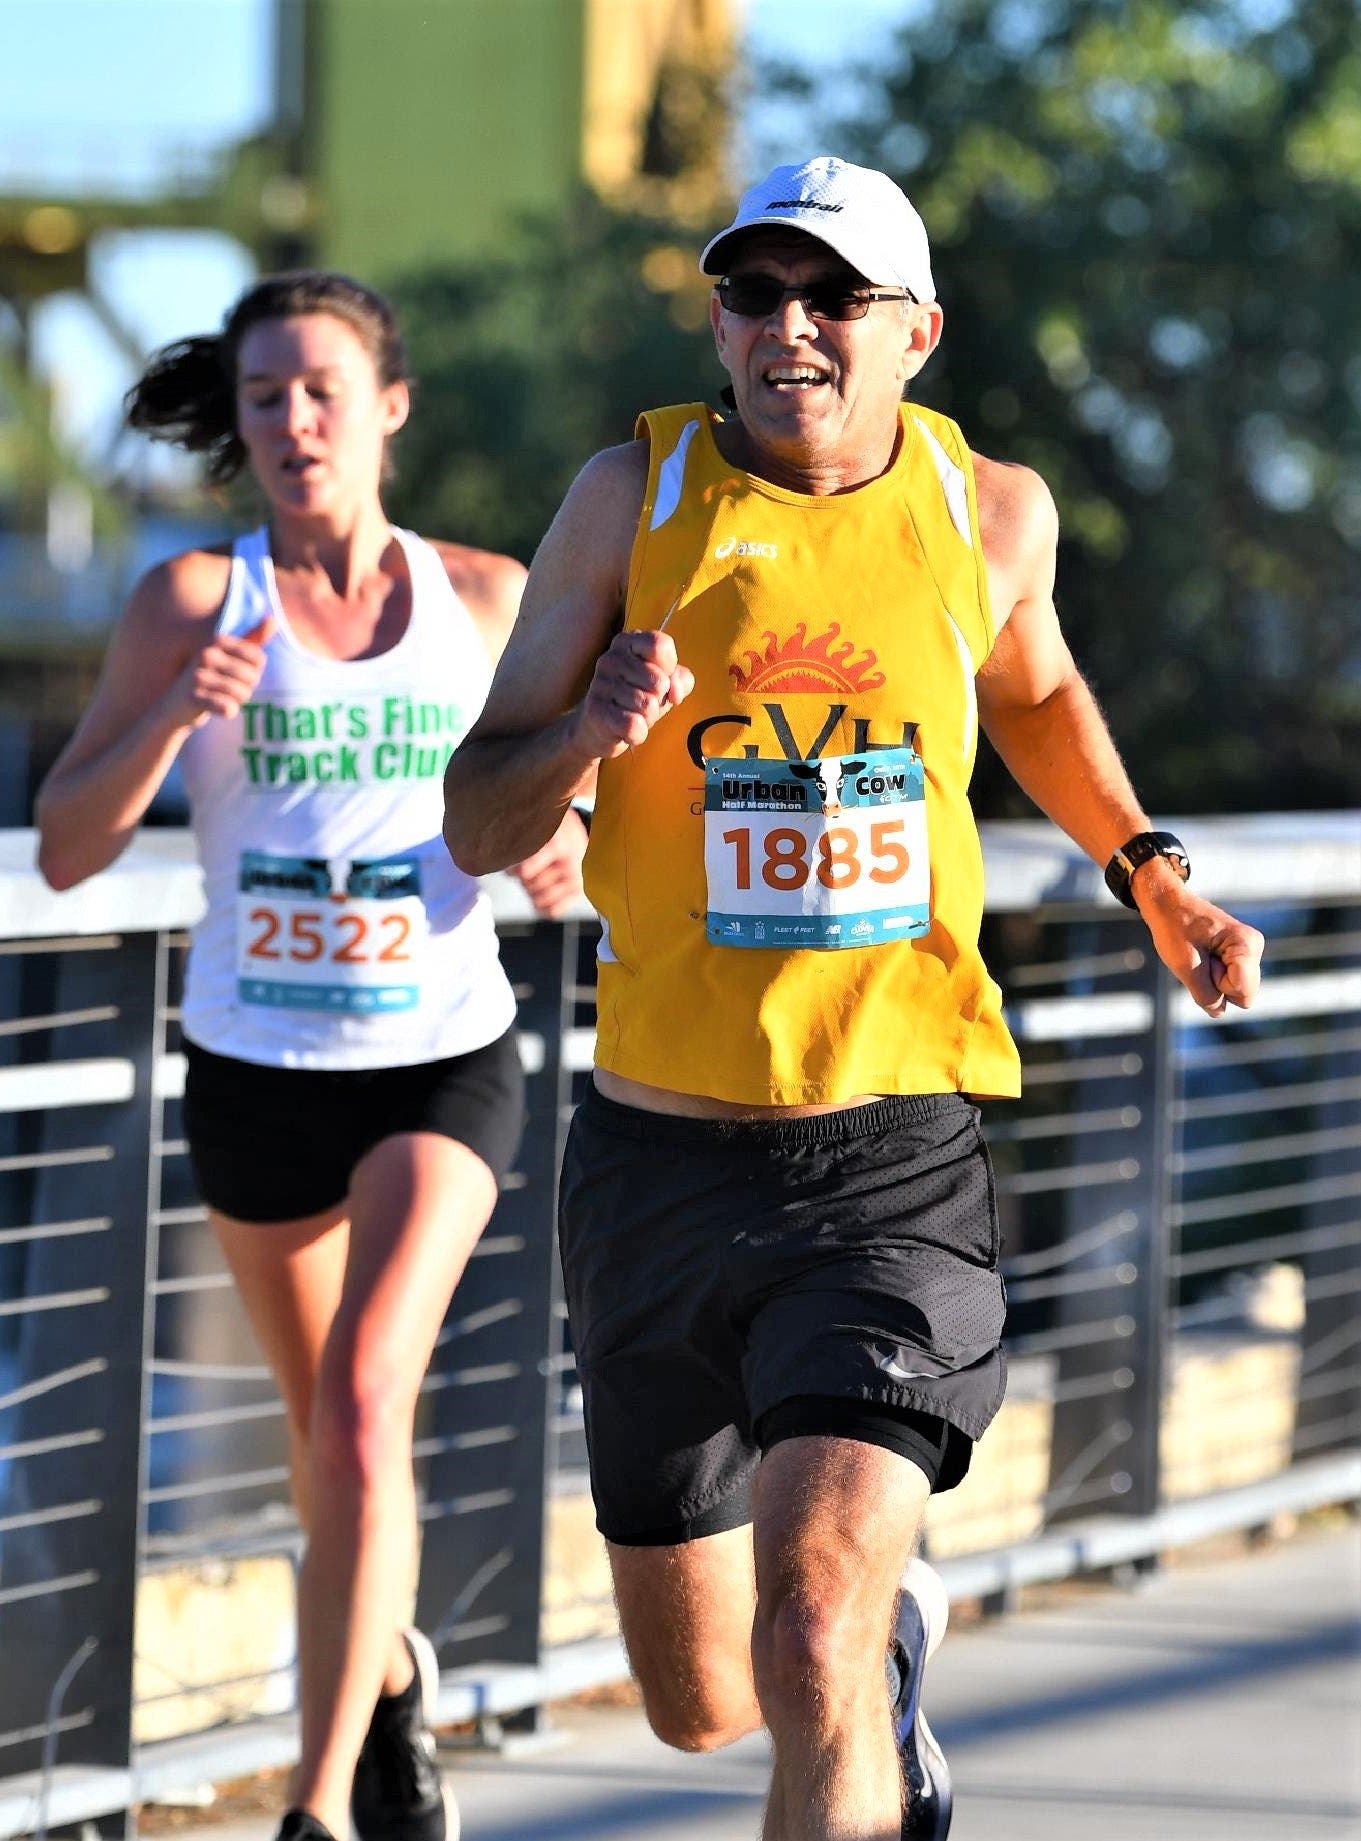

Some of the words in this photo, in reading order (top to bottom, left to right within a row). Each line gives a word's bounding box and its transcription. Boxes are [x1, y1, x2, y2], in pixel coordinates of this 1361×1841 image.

[736, 542, 778, 560] asics
[242, 703, 369, 742] That's
[384, 695, 463, 738] Fine
[241, 745, 359, 784] Track
[721, 778, 808, 801] Urban
[722, 801, 745, 809] Half
[747, 801, 802, 810] Marathon
[722, 819, 910, 891] 1885
[247, 907, 411, 963] 2522
